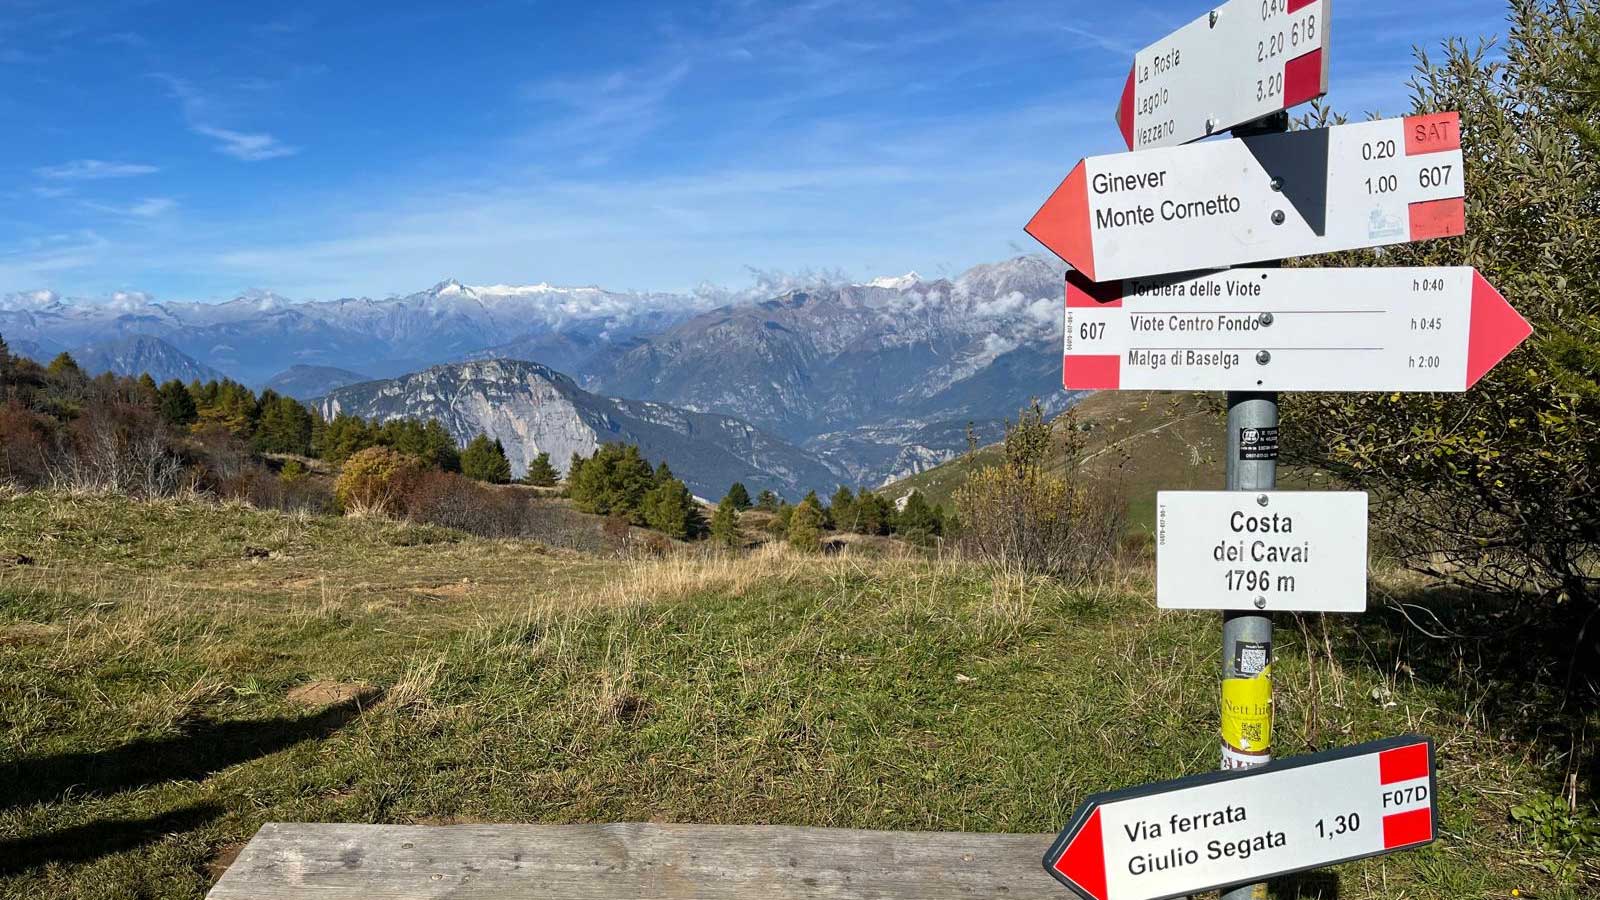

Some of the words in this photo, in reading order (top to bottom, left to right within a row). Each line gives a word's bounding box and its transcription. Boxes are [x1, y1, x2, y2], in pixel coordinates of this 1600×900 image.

[1292, 14, 1316, 47] 618
[1258, 31, 1284, 63] 2.20
[1138, 64, 1149, 84] La
[1153, 48, 1181, 75] Rosta
[1256, 72, 1282, 101] 3.20
[1137, 87, 1168, 116] Lagolo
[1137, 119, 1175, 145] Vezzano
[1415, 121, 1451, 141] SAT
[1362, 139, 1396, 160] 0.20
[1092, 170, 1166, 194] Ginever
[1365, 174, 1397, 194] 1.00
[1419, 165, 1453, 188] 607
[1095, 205, 1154, 230] Monte
[1160, 194, 1241, 220] Cornetto
[1131, 280, 1186, 297] Torbiera
[1190, 280, 1221, 297] delle
[1226, 280, 1261, 297] Viote
[1413, 279, 1419, 291] h
[1422, 279, 1444, 291] 0:40
[1080, 322, 1106, 340] 607
[1130, 315, 1164, 331] Viote
[1168, 315, 1213, 331] Centro
[1218, 316, 1259, 331] Fondo
[1411, 318, 1417, 330] h
[1420, 318, 1442, 330] 0:45
[1128, 350, 1166, 369] Malga
[1171, 350, 1182, 366] di
[1186, 350, 1239, 369] Baselga
[1408, 356, 1415, 368] h
[1418, 356, 1440, 368] 2:00
[1230, 511, 1293, 533] Costa
[1213, 540, 1244, 562] dei
[1251, 540, 1309, 563] Cavai
[1225, 570, 1270, 592] 1796
[1277, 575, 1295, 592] m
[1382, 785, 1428, 808] F07D
[1124, 819, 1161, 843] Via
[1169, 805, 1247, 834] ferrata
[1314, 812, 1360, 840] 1,30
[1128, 847, 1199, 876] Giulio
[1207, 830, 1287, 860] Segata
